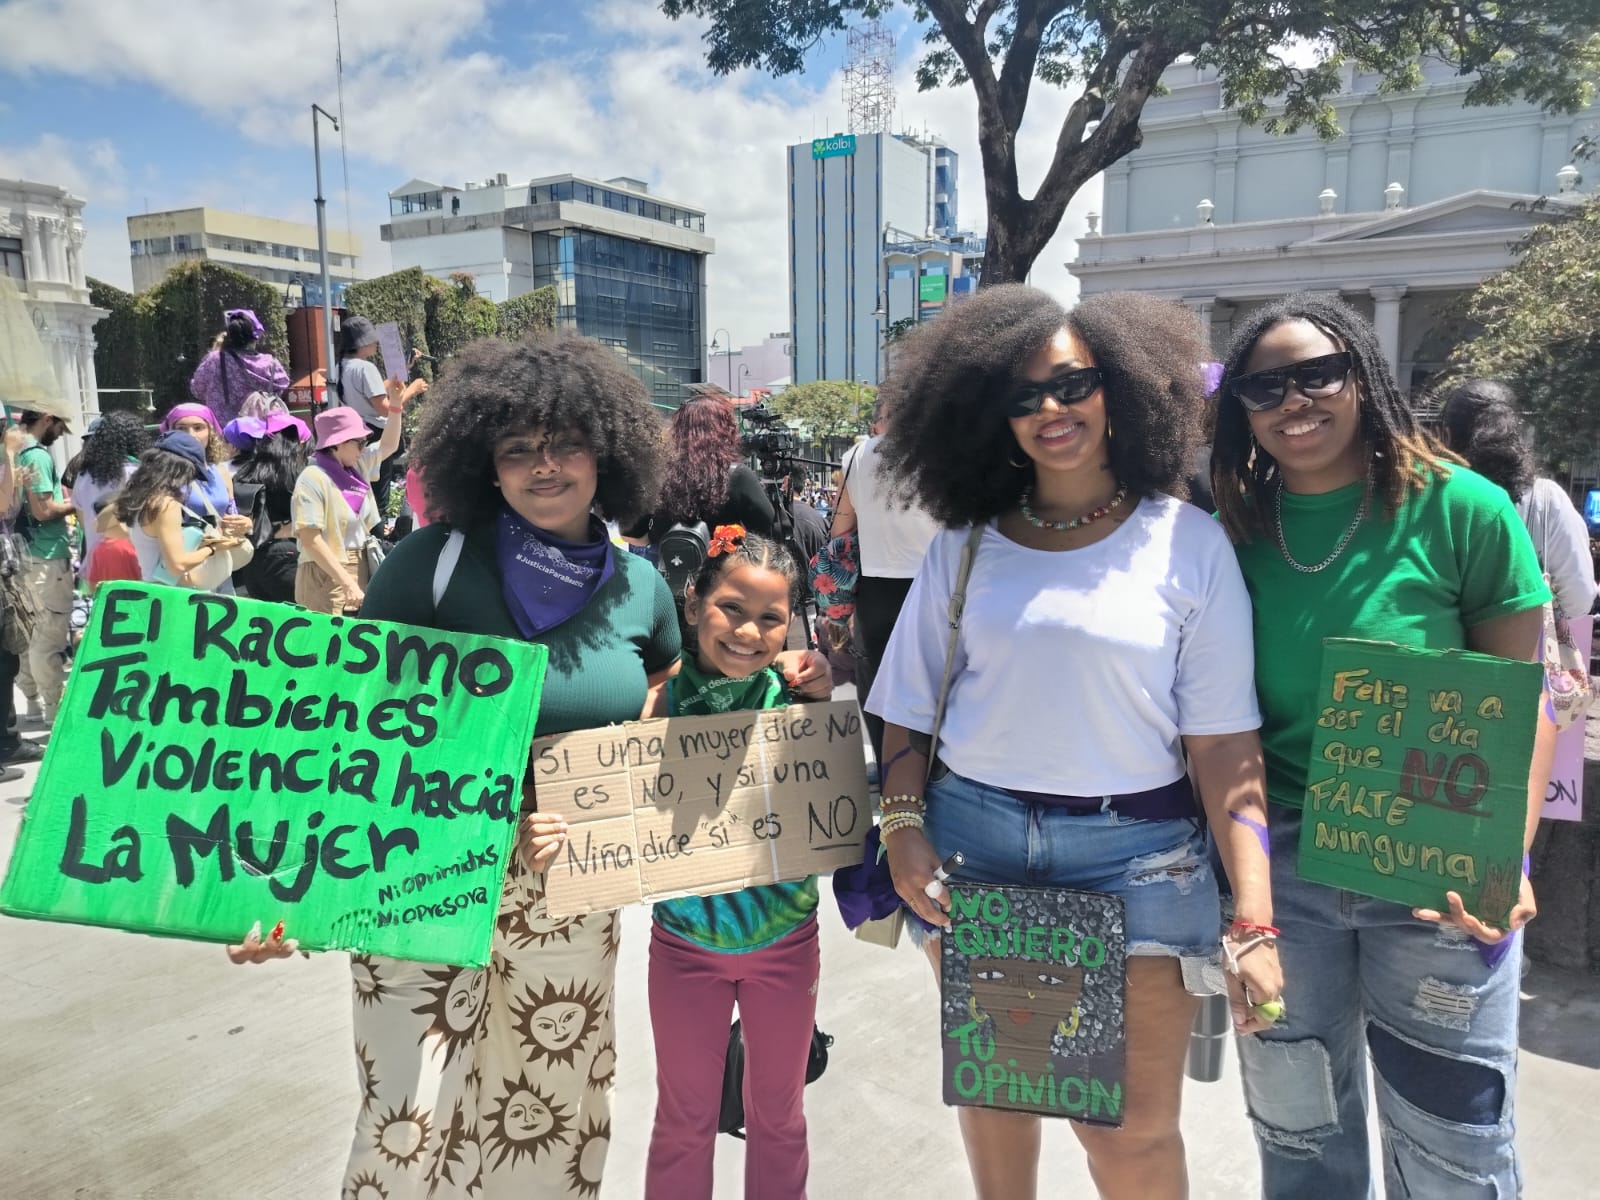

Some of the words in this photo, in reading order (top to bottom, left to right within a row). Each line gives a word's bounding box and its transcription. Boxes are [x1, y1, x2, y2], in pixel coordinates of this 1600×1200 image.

[100, 589, 160, 648] El
[190, 594, 513, 697] Racismo
[1333, 668, 1409, 709] Feliz
[1428, 690, 1462, 715] va
[1476, 696, 1504, 720] a
[679, 723, 753, 761] mujer
[764, 717, 817, 743] dice
[1317, 707, 1364, 730] ser
[1377, 711, 1403, 737] el
[100, 729, 379, 802] Violencia
[392, 751, 516, 824] hacia
[574, 783, 610, 810] es
[773, 757, 830, 784] una
[1324, 742, 1383, 775] que
[1400, 748, 1489, 808] NO
[1308, 777, 1416, 827] FALTE
[59, 793, 144, 885] La
[165, 804, 420, 904] Mujer
[567, 830, 635, 877] Niña
[641, 830, 693, 865] dice
[752, 813, 782, 839] es
[808, 795, 857, 844] NO
[1315, 822, 1481, 886] Ninguna
[949, 889, 1010, 925] NO
[947, 1020, 996, 1062] TU
